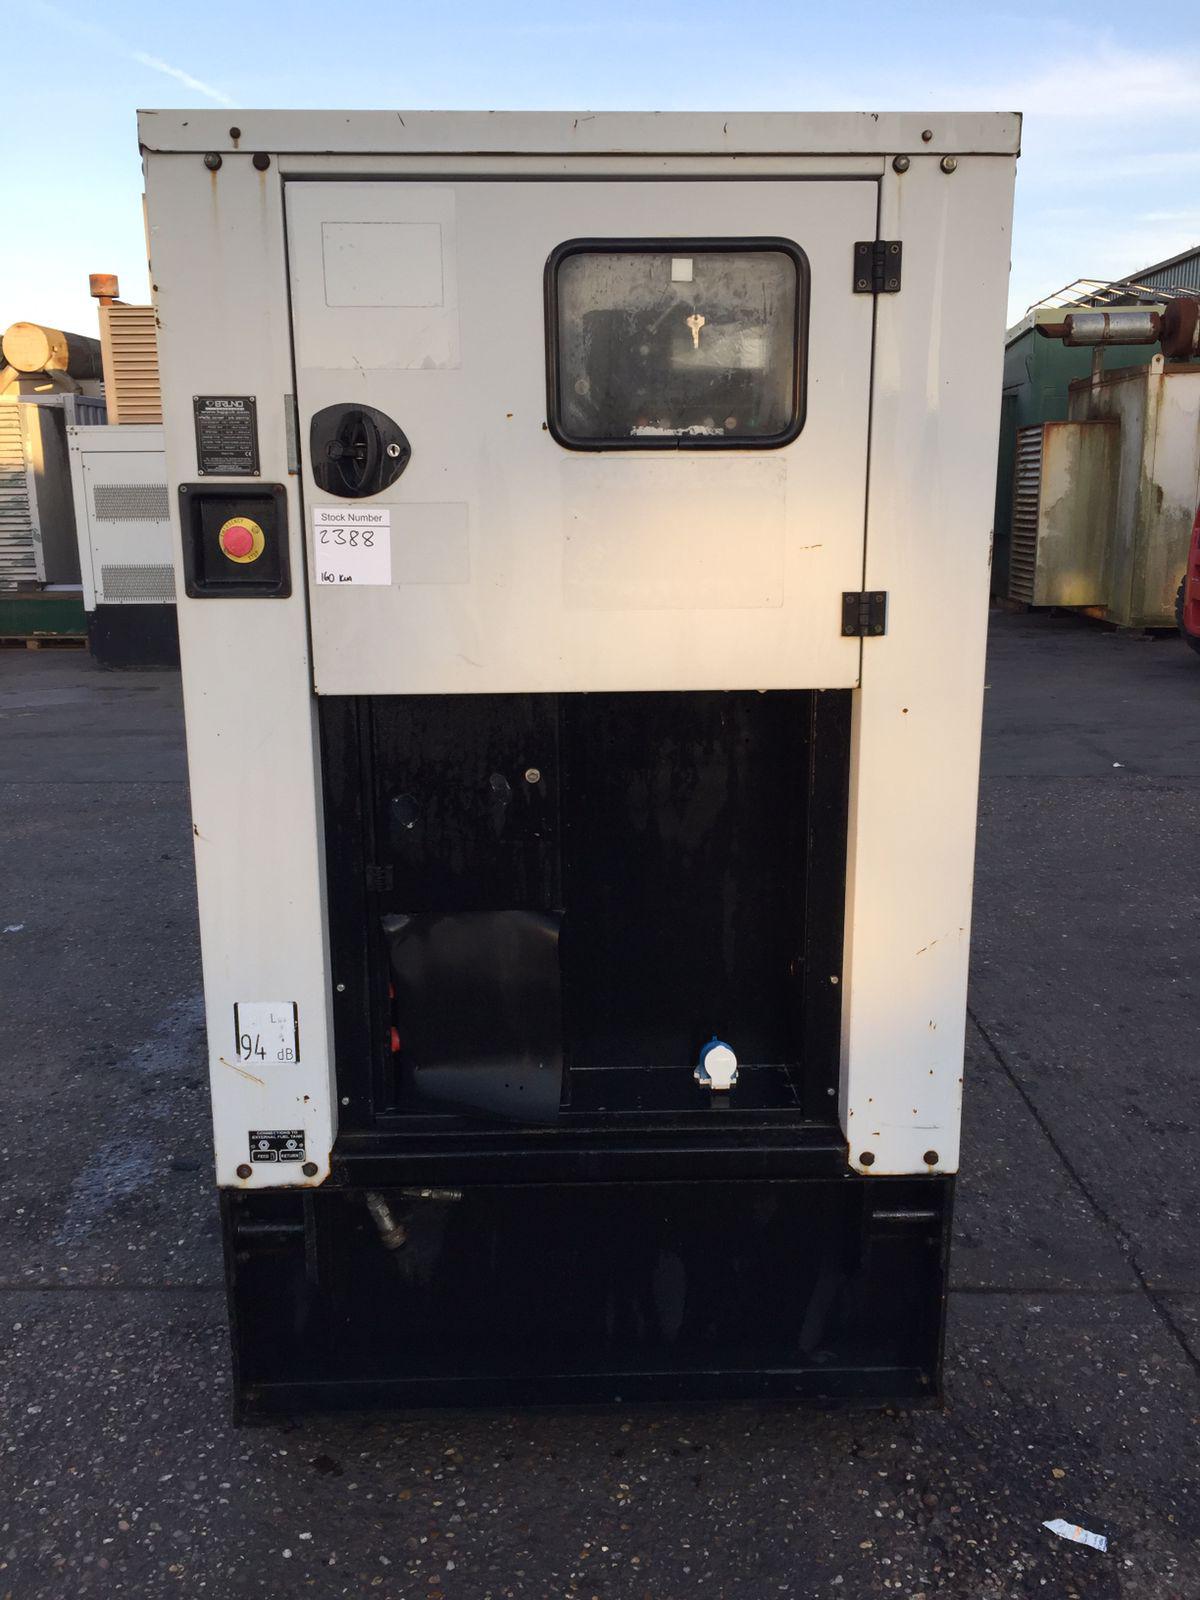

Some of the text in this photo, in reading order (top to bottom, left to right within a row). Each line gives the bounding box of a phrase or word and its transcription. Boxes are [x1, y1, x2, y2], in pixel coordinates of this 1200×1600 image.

[214, 400, 244, 408] BRUNO
[321, 513, 383, 523] Stock Number
[319, 528, 375, 547] 2388
[321, 571, 335, 583] 160
[240, 1033, 267, 1061] 94
[277, 1047, 294, 1061] dB
